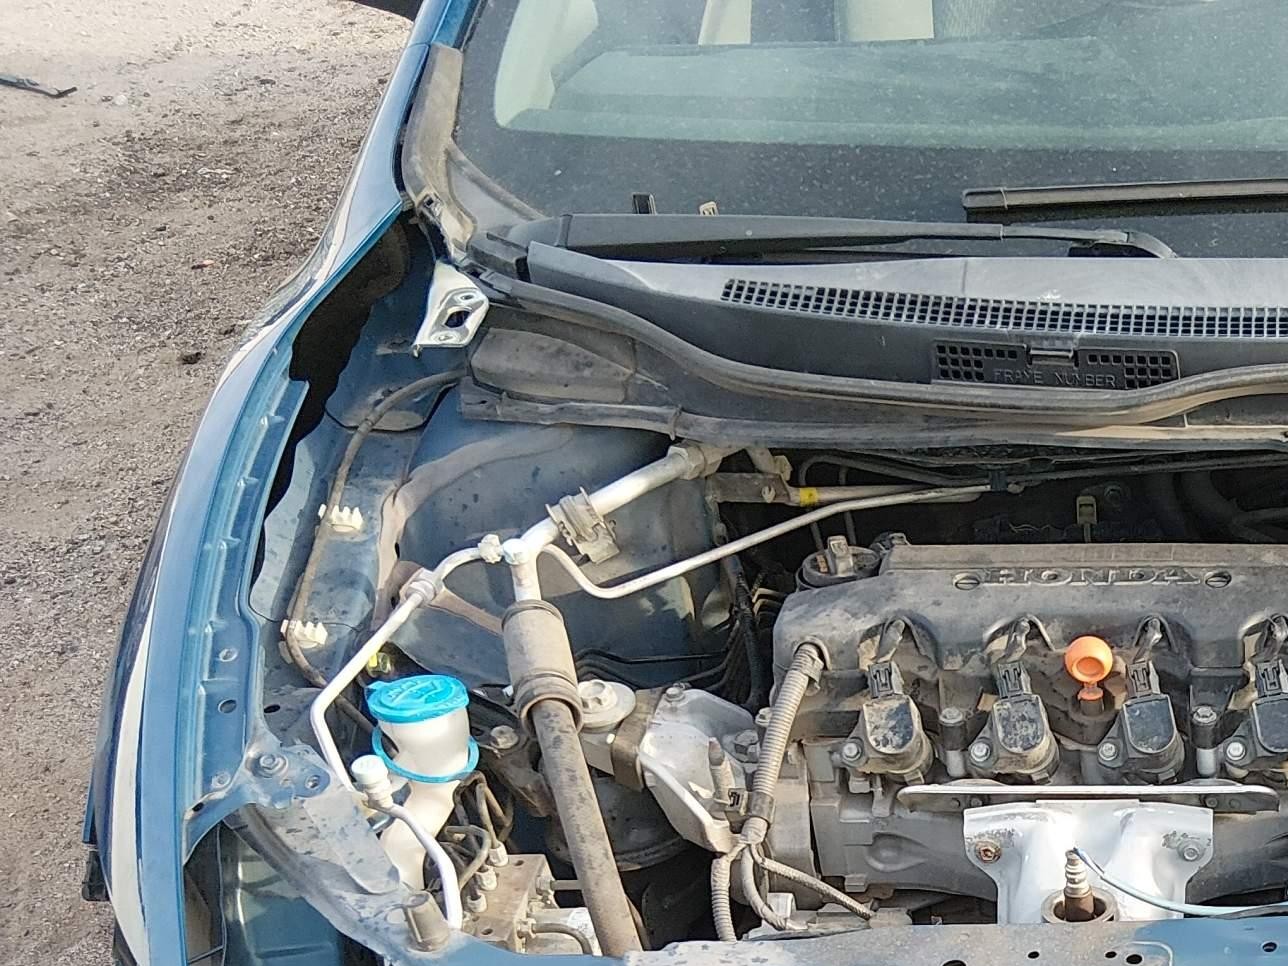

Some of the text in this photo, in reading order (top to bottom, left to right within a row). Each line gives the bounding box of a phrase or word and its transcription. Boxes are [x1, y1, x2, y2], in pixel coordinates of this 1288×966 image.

[993, 368, 1116, 387] FRAME NUMBER
[982, 566, 1201, 586] HONDA
